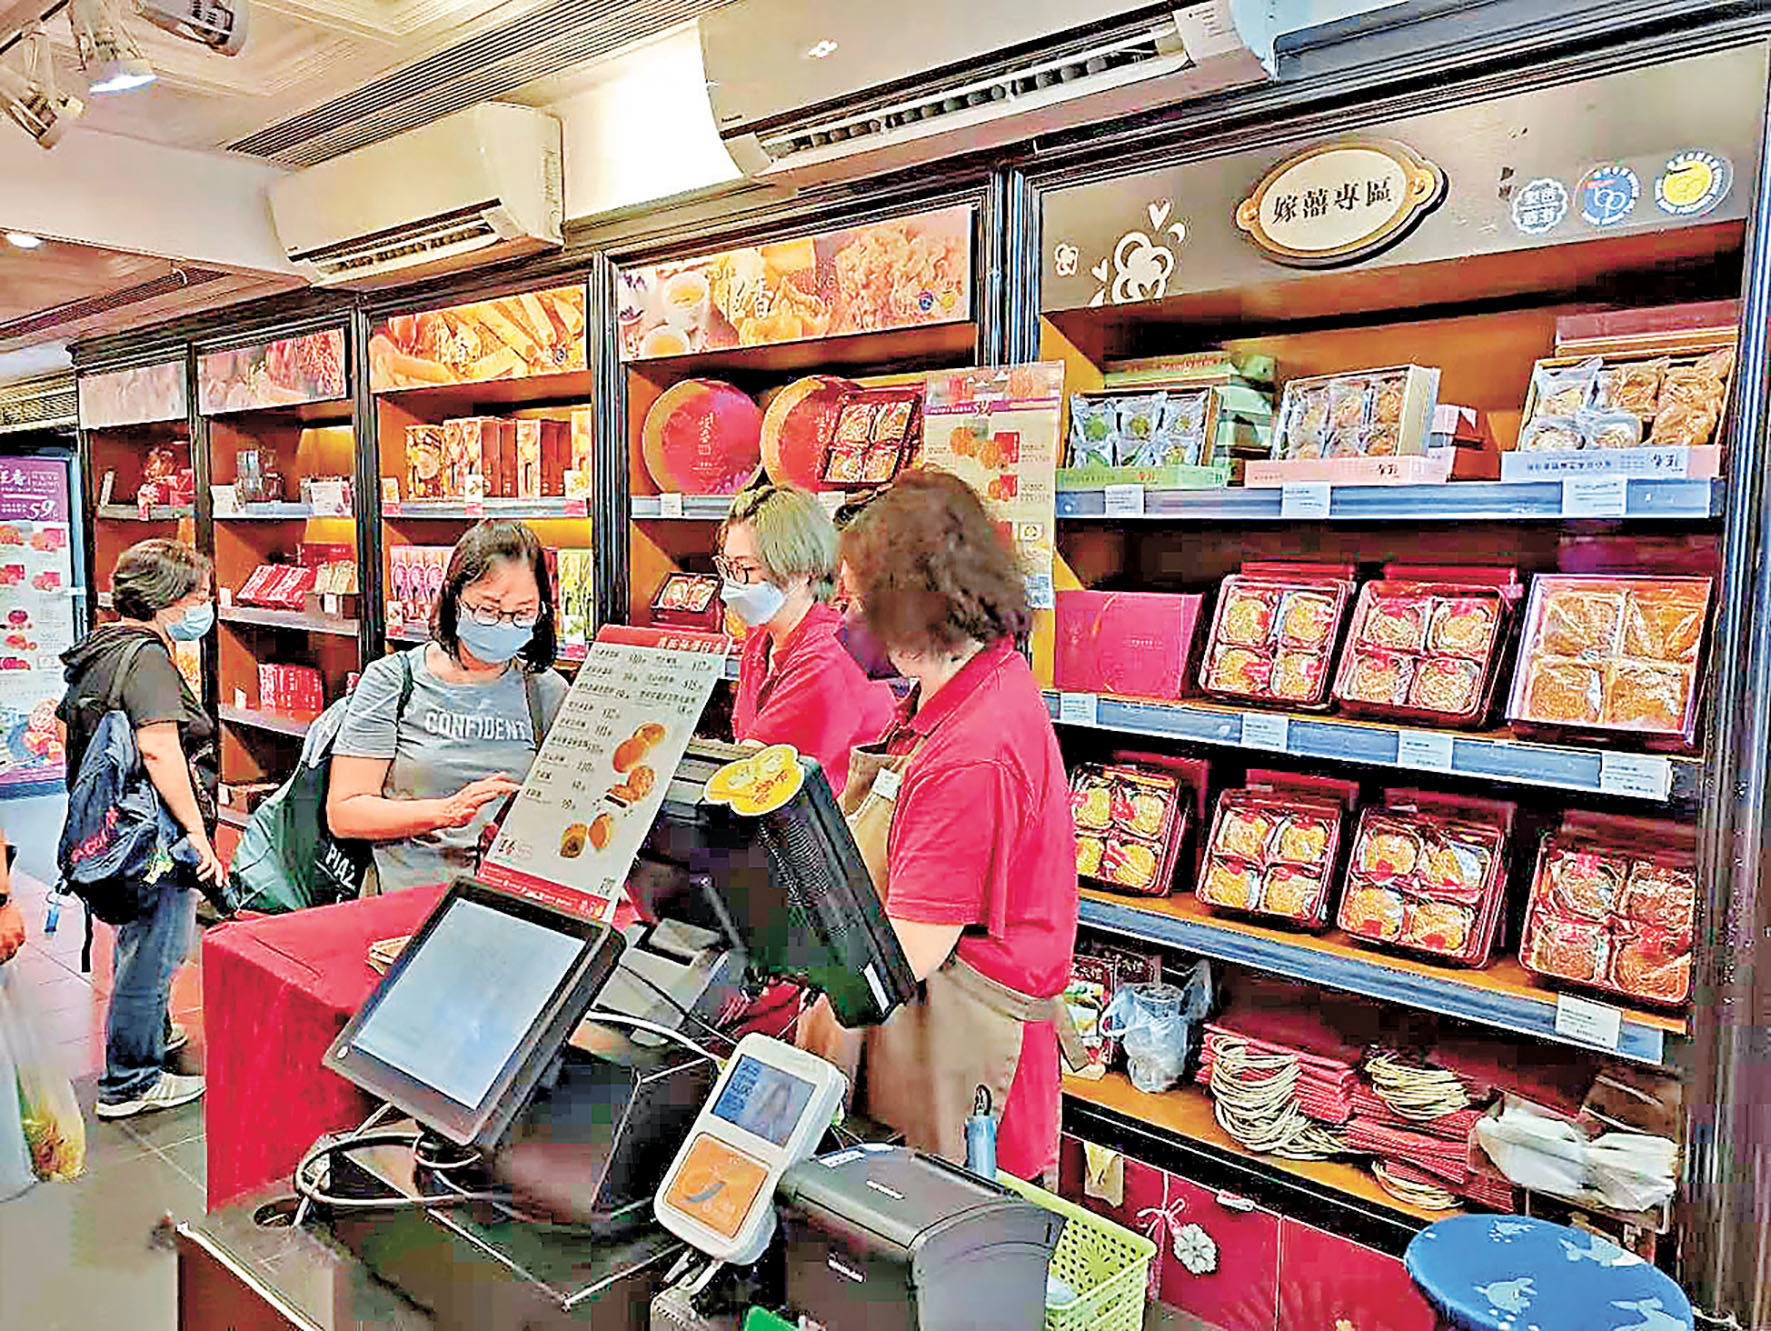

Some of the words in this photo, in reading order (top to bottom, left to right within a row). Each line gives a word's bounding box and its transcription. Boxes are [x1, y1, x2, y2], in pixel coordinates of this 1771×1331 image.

[1273, 175, 1392, 224] 嫁囍專區
[425, 710, 527, 741] CONFIDENT
